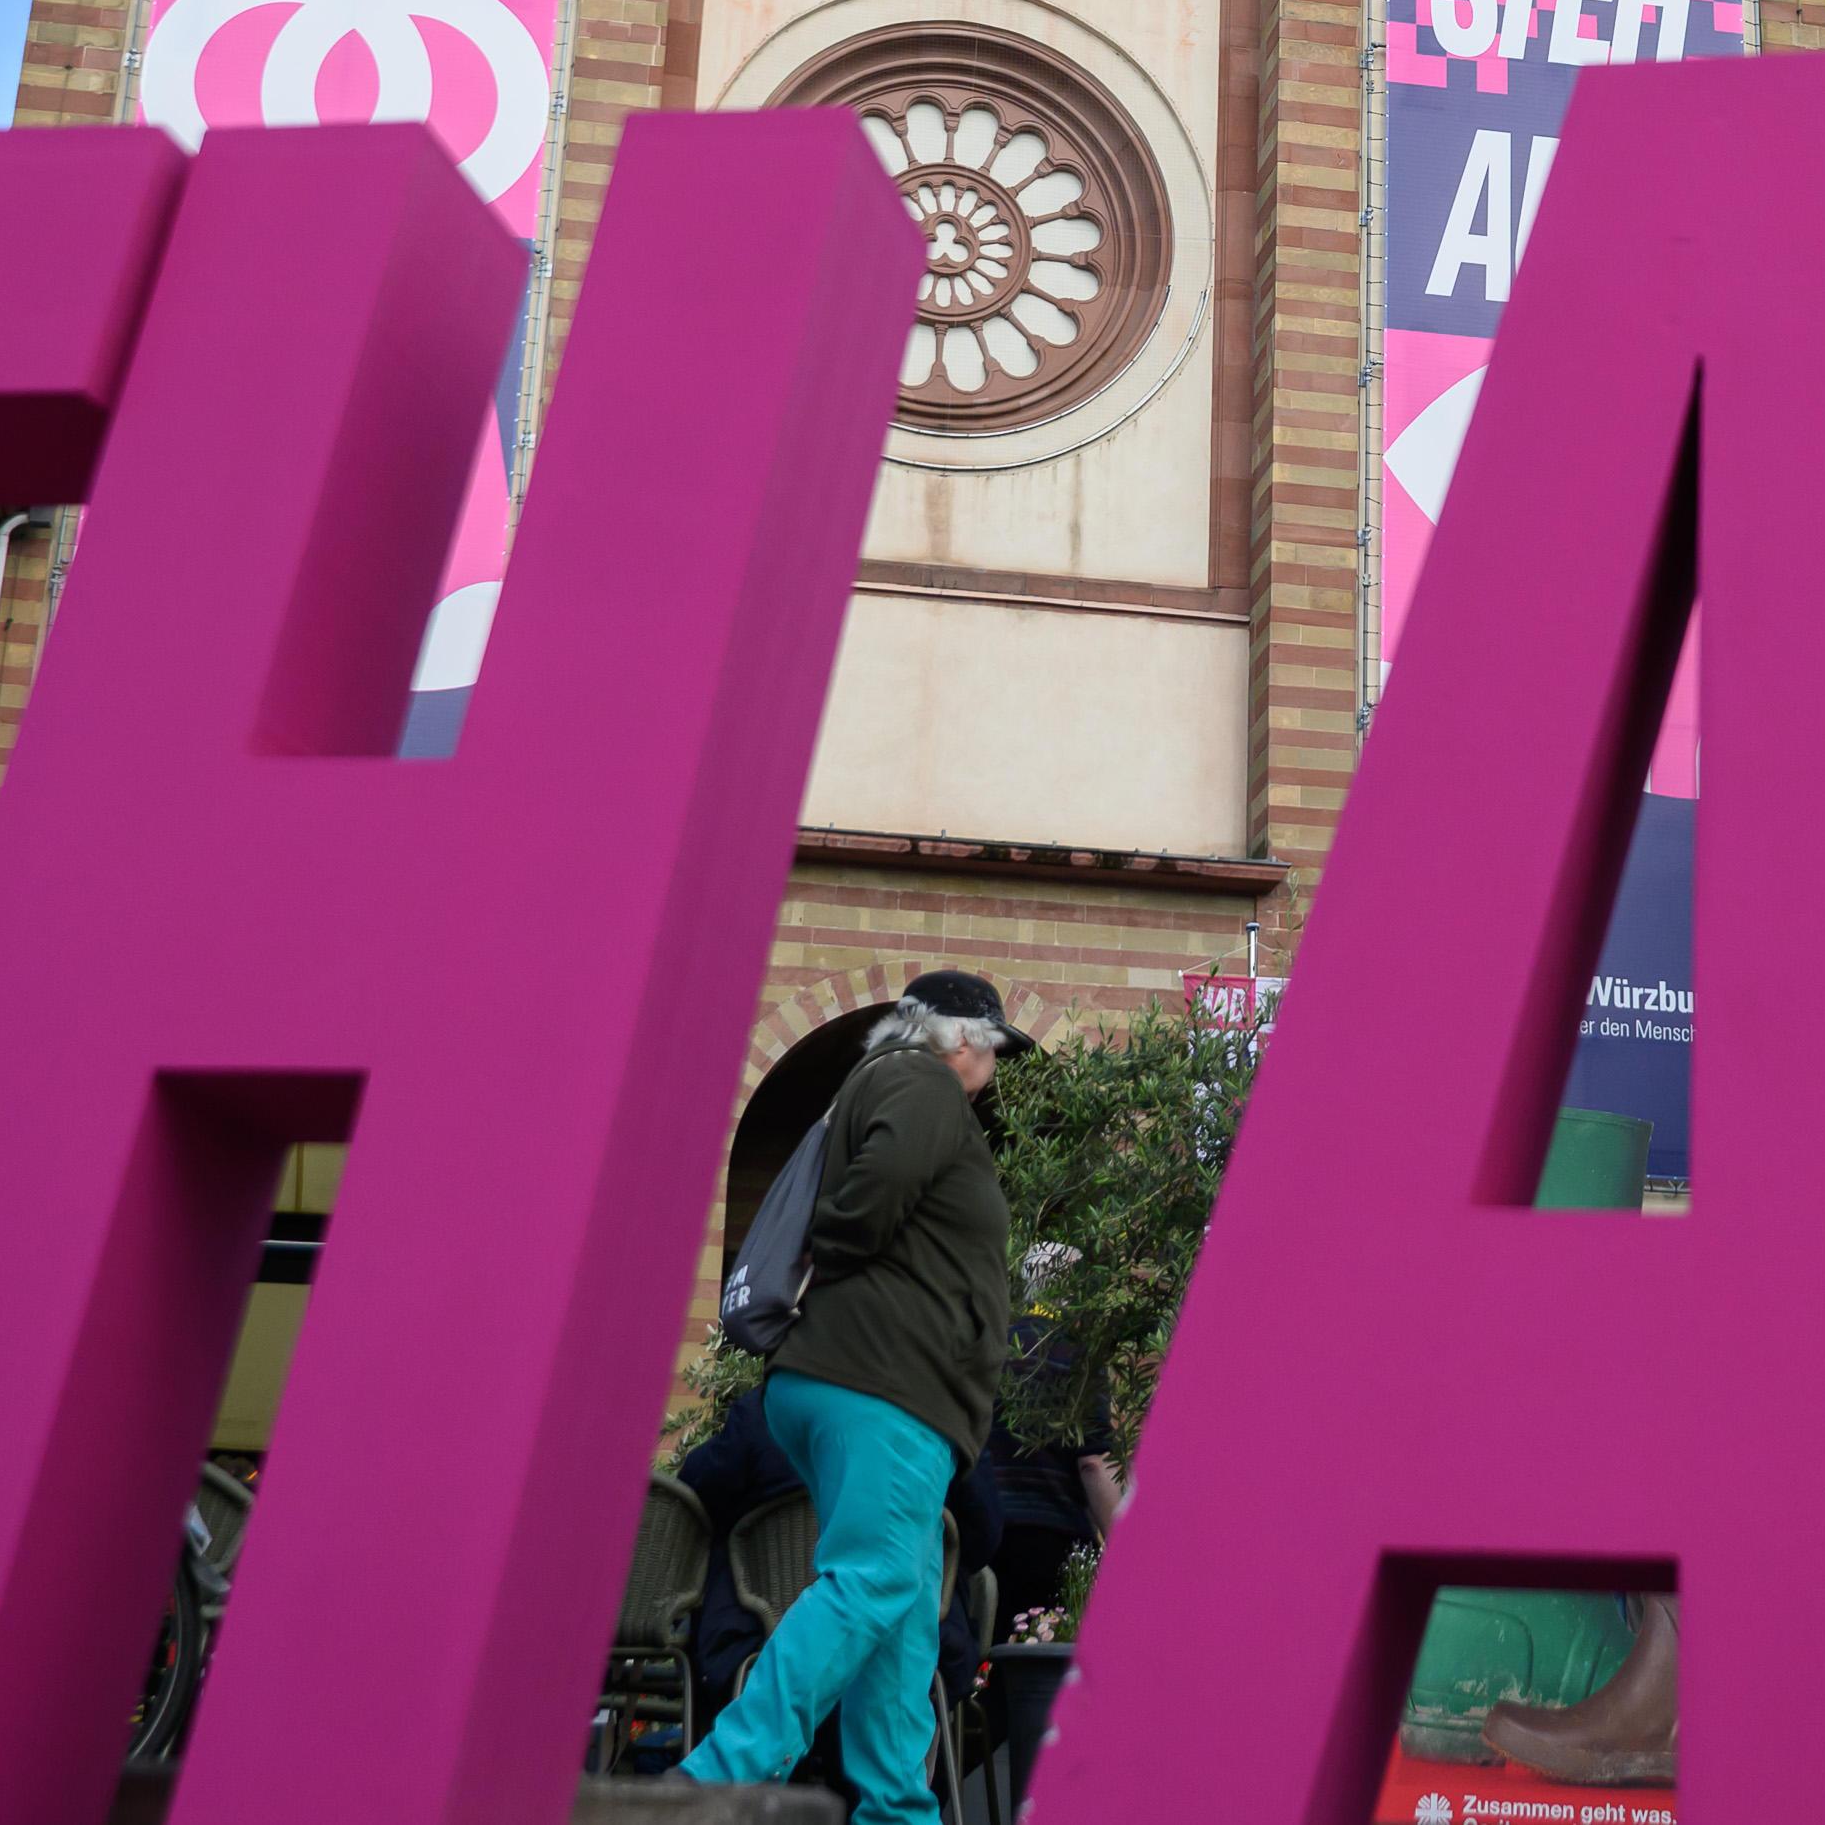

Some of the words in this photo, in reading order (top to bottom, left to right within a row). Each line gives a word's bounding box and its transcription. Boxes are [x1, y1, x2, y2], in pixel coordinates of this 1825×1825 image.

[1425, 129, 1561, 302] A
[1586, 975, 1695, 1013] Würzbu
[1579, 1020, 1595, 1035] er
[1600, 1017, 1630, 1037] den
[722, 1285, 751, 1315] ER
[1462, 1795, 1574, 1820] Zusammen
[1581, 1803, 1626, 1824] geht
